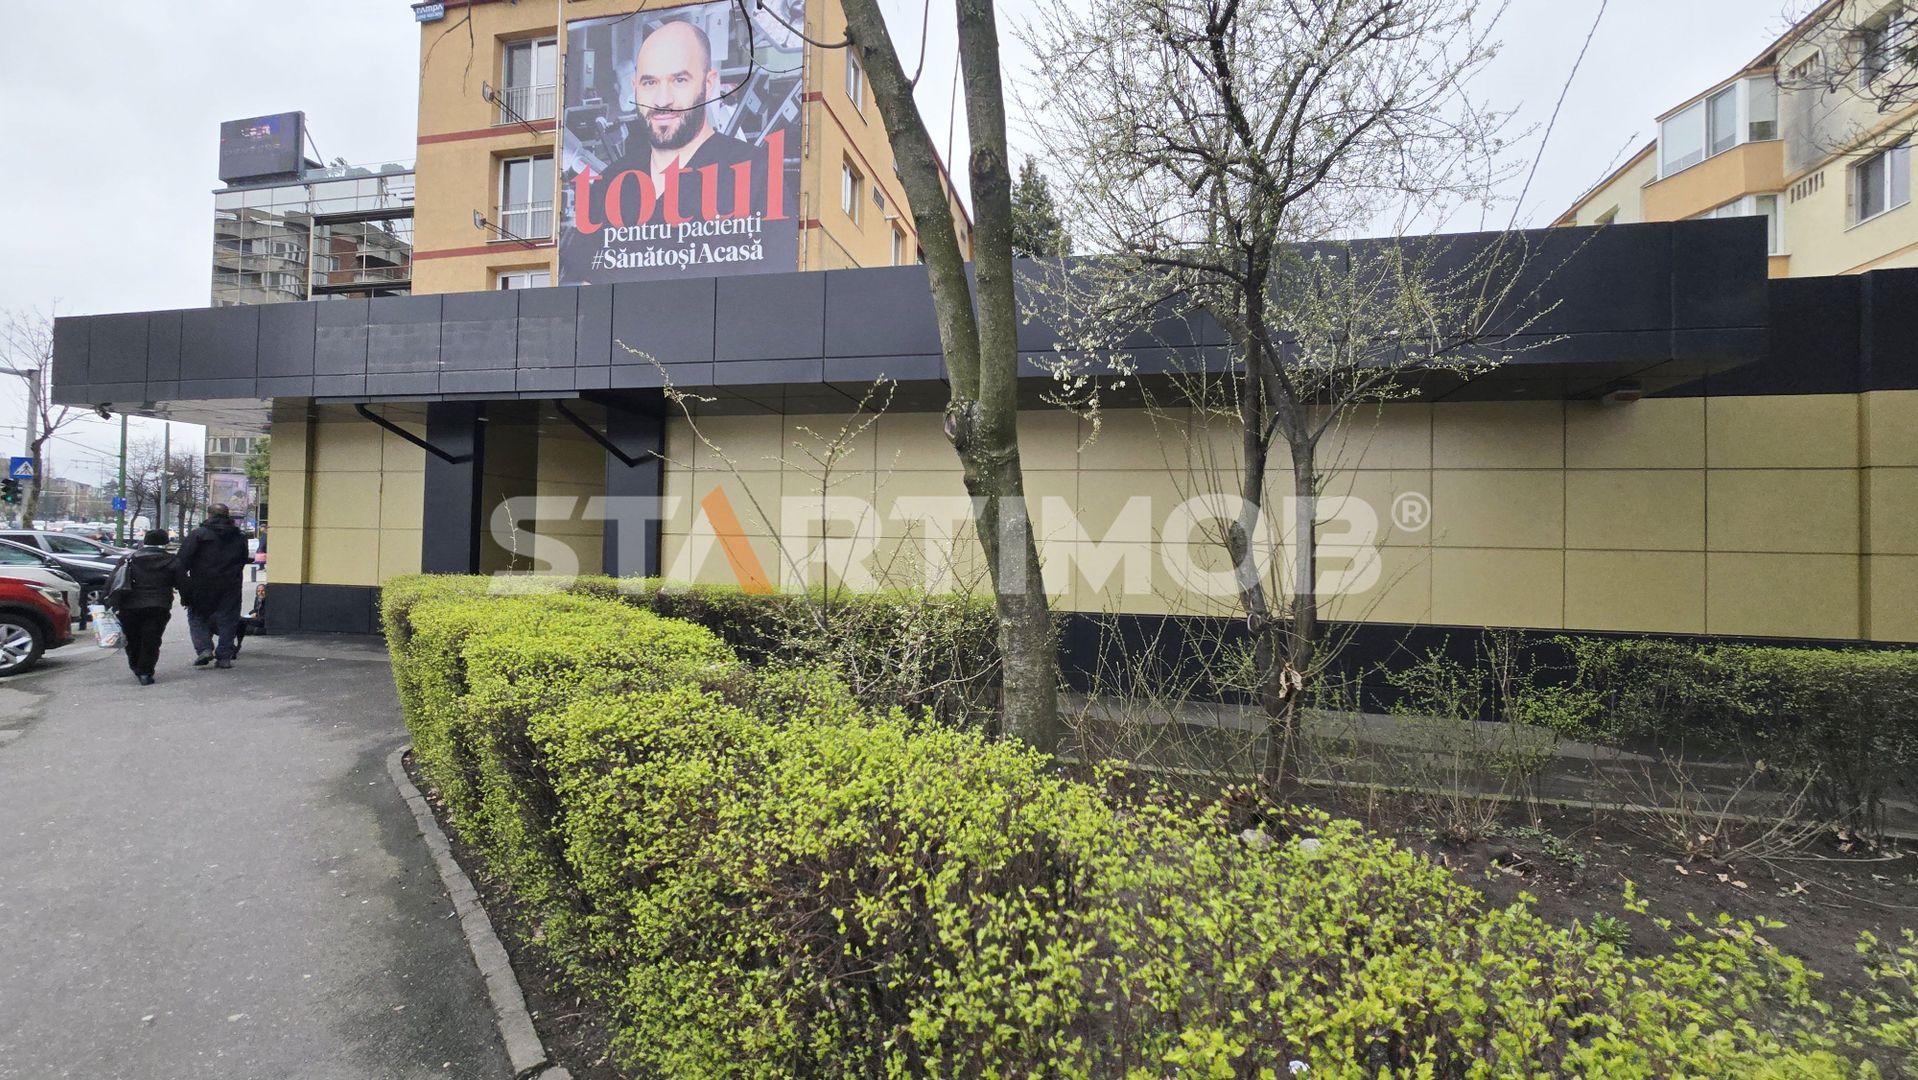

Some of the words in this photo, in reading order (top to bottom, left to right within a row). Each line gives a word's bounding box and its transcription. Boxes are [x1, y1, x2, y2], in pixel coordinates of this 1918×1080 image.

[571, 128, 790, 235] totul
[603, 222, 673, 248] pentru
[678, 211, 762, 244] pacienți
[591, 239, 764, 271] #SănătoșiAcasă
